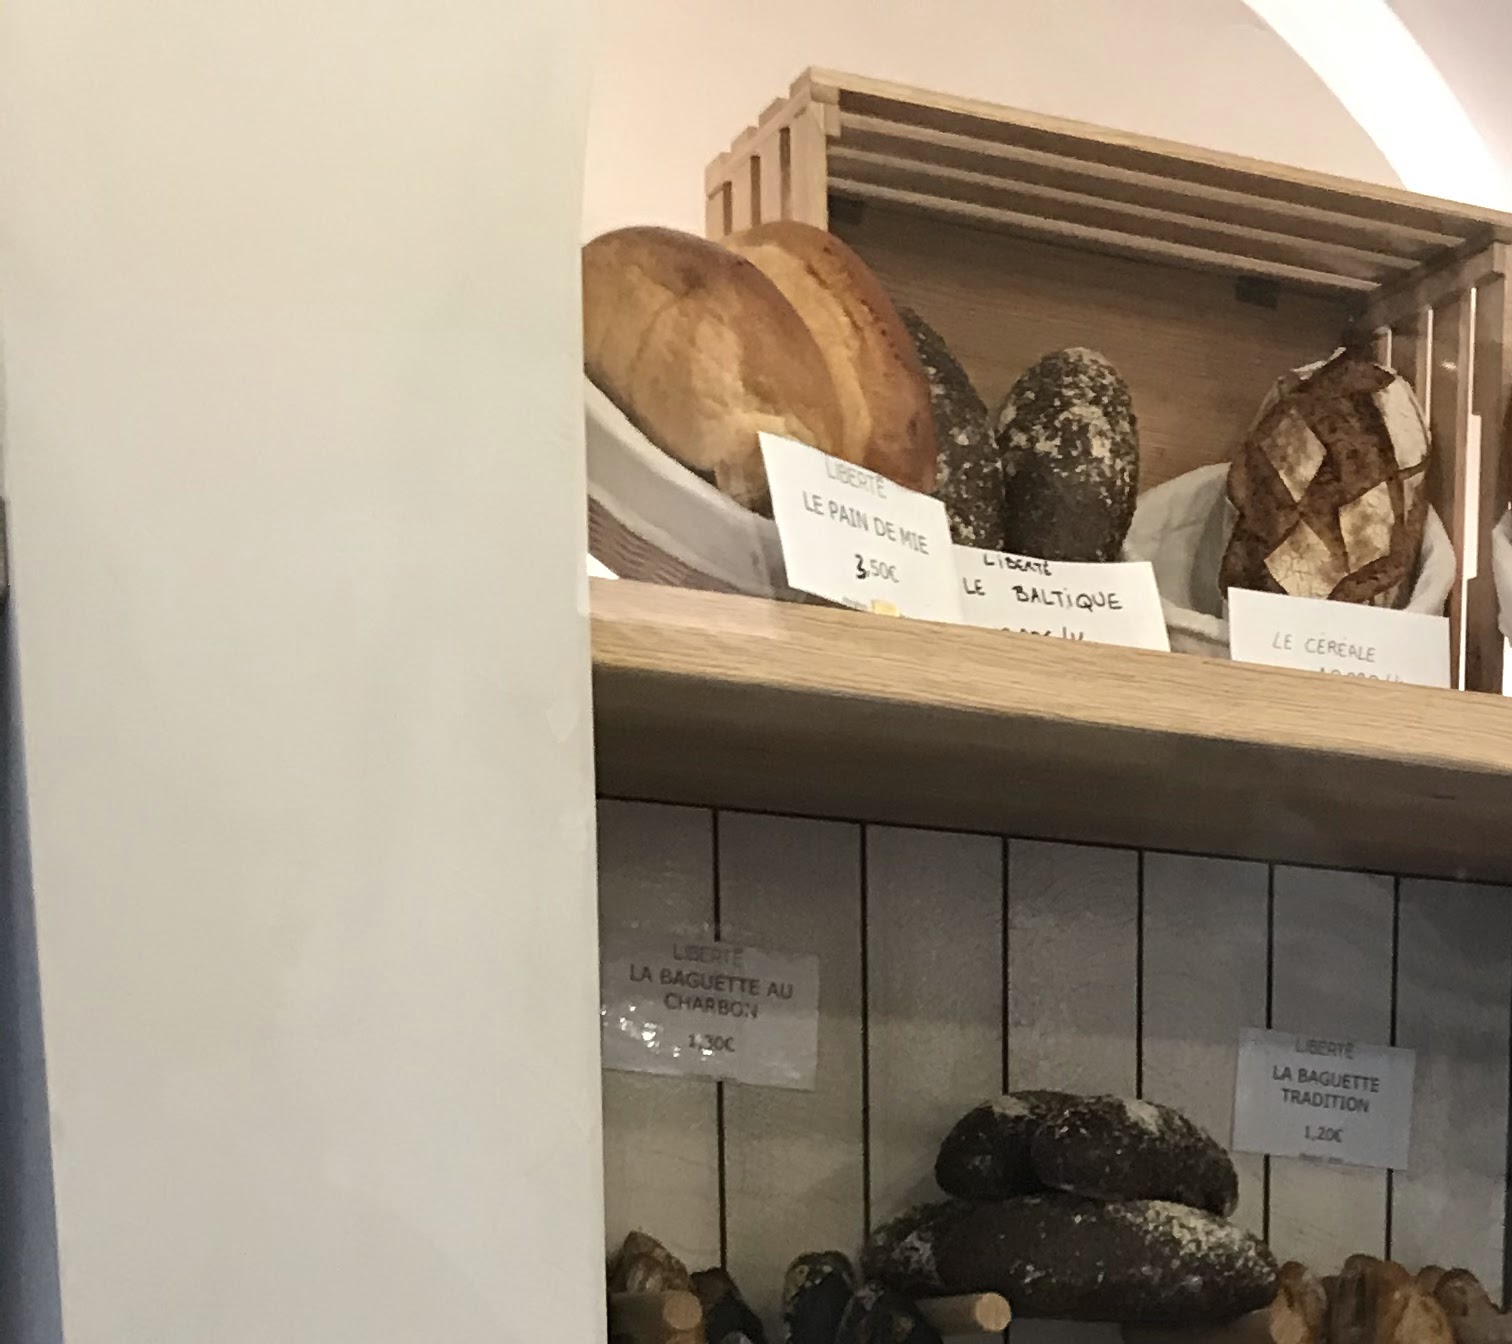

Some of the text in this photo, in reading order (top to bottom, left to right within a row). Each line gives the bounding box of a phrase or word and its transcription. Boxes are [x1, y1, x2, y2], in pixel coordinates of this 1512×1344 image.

[802, 490, 929, 555] LE PAIN DE MIE
[962, 577, 985, 596] LE
[1272, 631, 1293, 650] LE
[629, 964, 794, 999] LA BAGUETTE AU
[664, 992, 758, 1019] CHARBON
[1273, 1065, 1380, 1092] LA BAGUETTE
[1281, 1088, 1369, 1112] TRADITION
[1304, 1125, 1343, 1143] 1,20€
